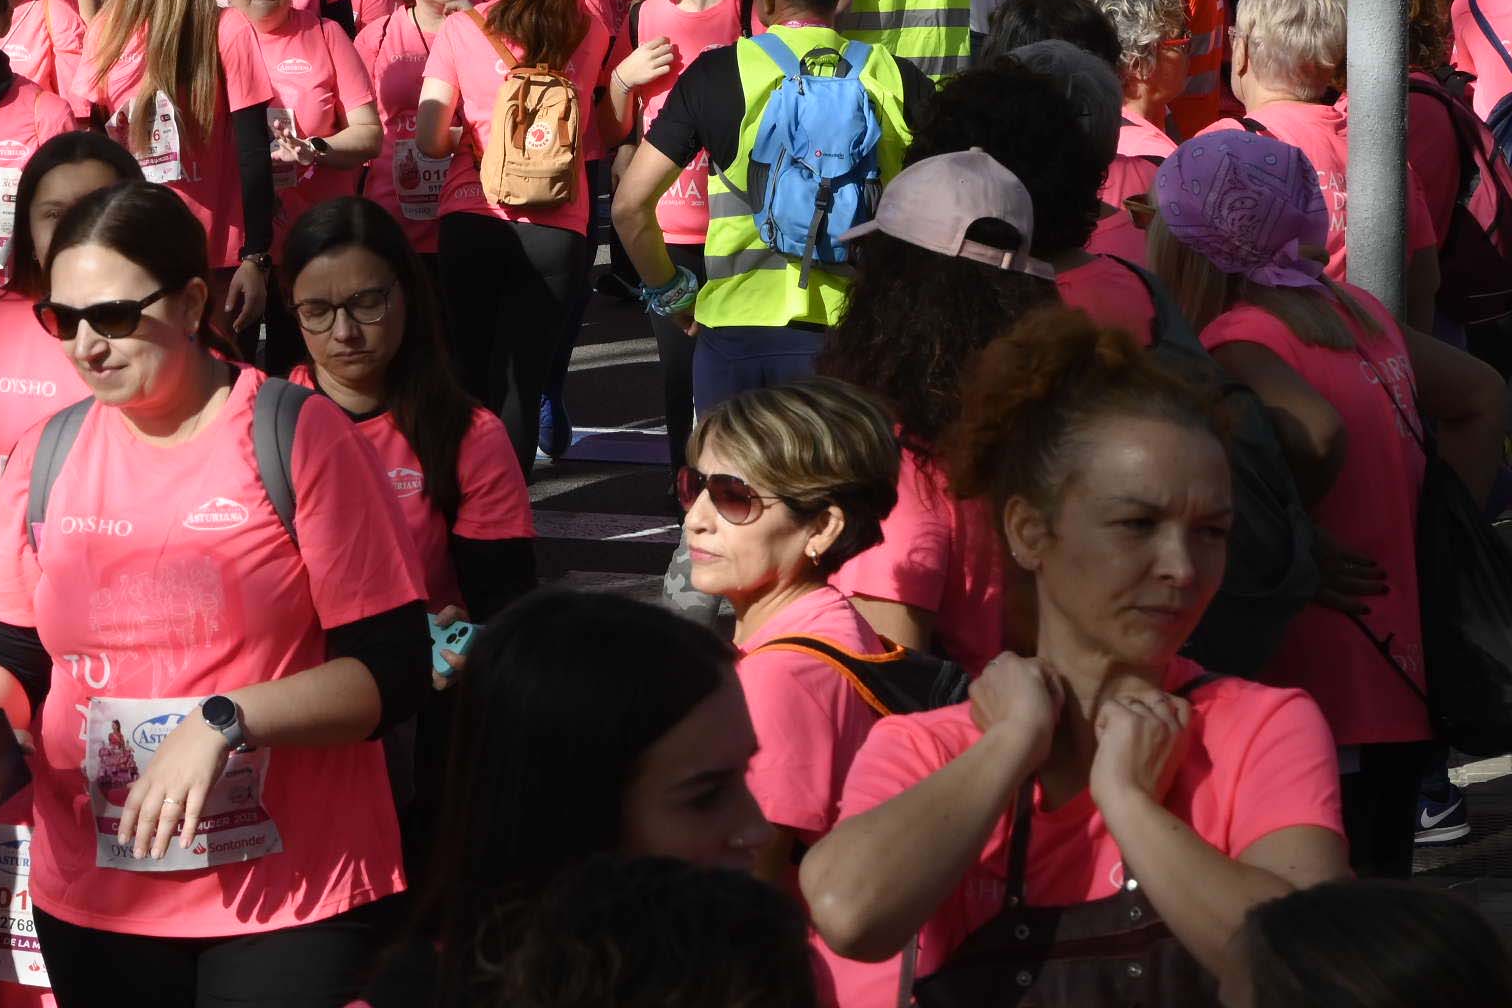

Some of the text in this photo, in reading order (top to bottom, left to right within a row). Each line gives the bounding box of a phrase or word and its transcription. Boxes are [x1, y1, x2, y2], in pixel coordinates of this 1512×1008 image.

[61, 516, 133, 537] OYSHO
[208, 834, 266, 854] Santander
[18, 938, 30, 949] LA
